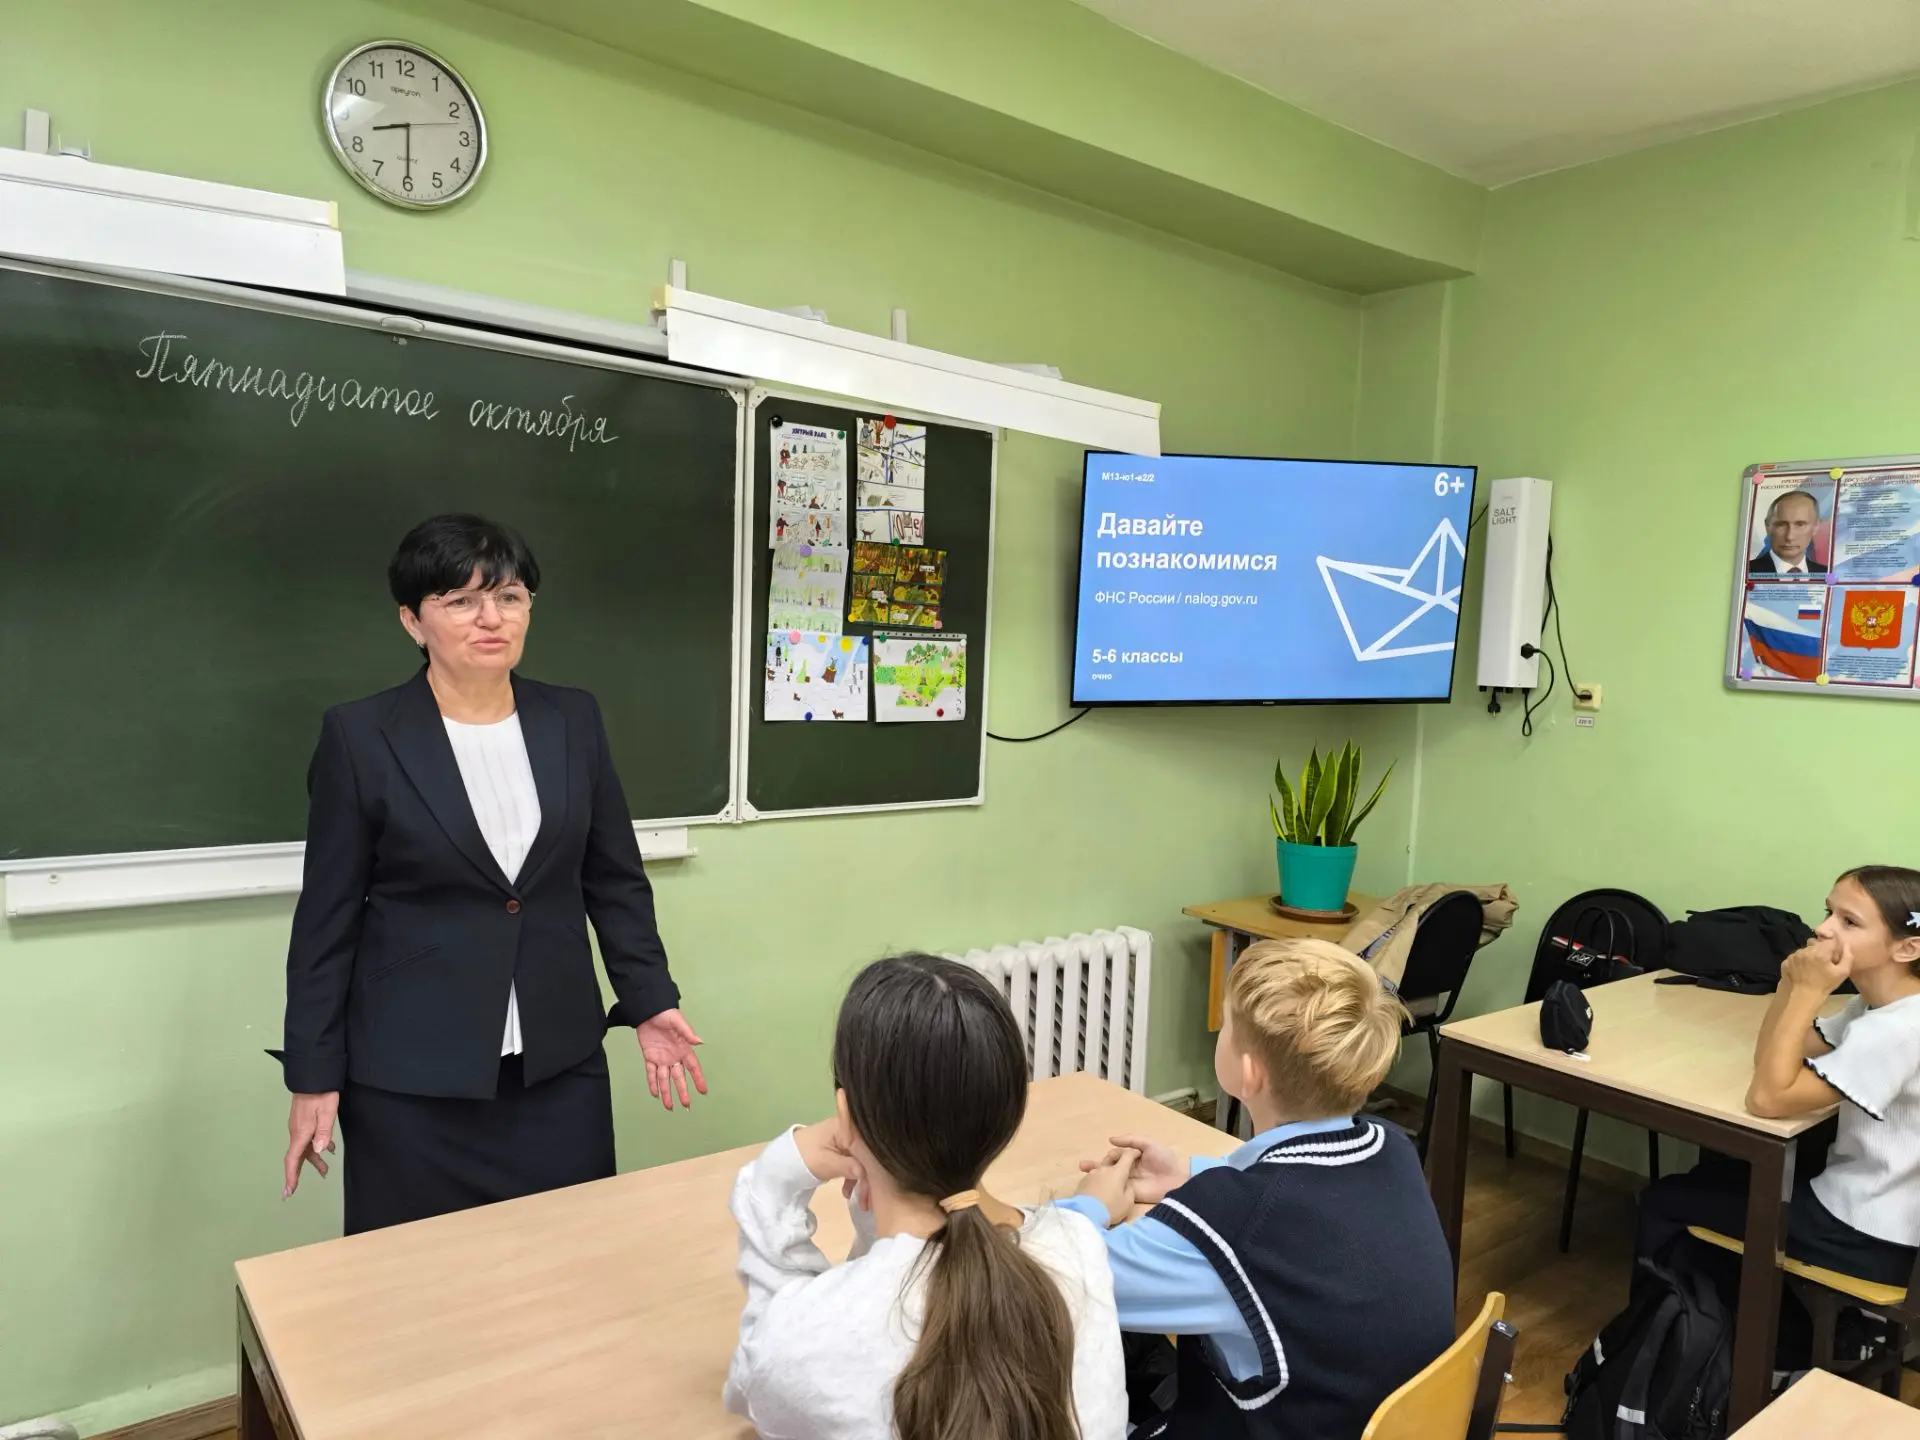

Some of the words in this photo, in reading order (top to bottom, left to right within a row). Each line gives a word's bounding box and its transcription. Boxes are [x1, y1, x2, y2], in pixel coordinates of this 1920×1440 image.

[369, 60, 384, 79] 11
[395, 59, 415, 78] 12
[347, 77, 366, 96] 10
[432, 75, 439, 92] 1
[449, 102, 460, 119] 2
[352, 136, 363, 152] 8
[459, 131, 470, 147] 3
[372, 159, 384, 176] 7
[450, 157, 461, 173] 4
[402, 176, 414, 192] 6
[432, 172, 443, 188] 5
[136, 330, 440, 427] Пятнадцатое
[468, 395, 620, 449] октября
[1433, 471, 1466, 497] 6+
[1493, 506, 1516, 517] SALT
[1097, 512, 1204, 538] Давайте
[1492, 515, 1516, 526] LIGHT
[1096, 550, 1278, 572] познакомимся
[1095, 592, 1126, 605] ФНС
[1128, 592, 1175, 605] России
[1184, 593, 1259, 607] nalog.gov.ru
[1091, 649, 1117, 664] 5-6
[1121, 651, 1184, 664] классы
[1091, 673, 1113, 681] очно
